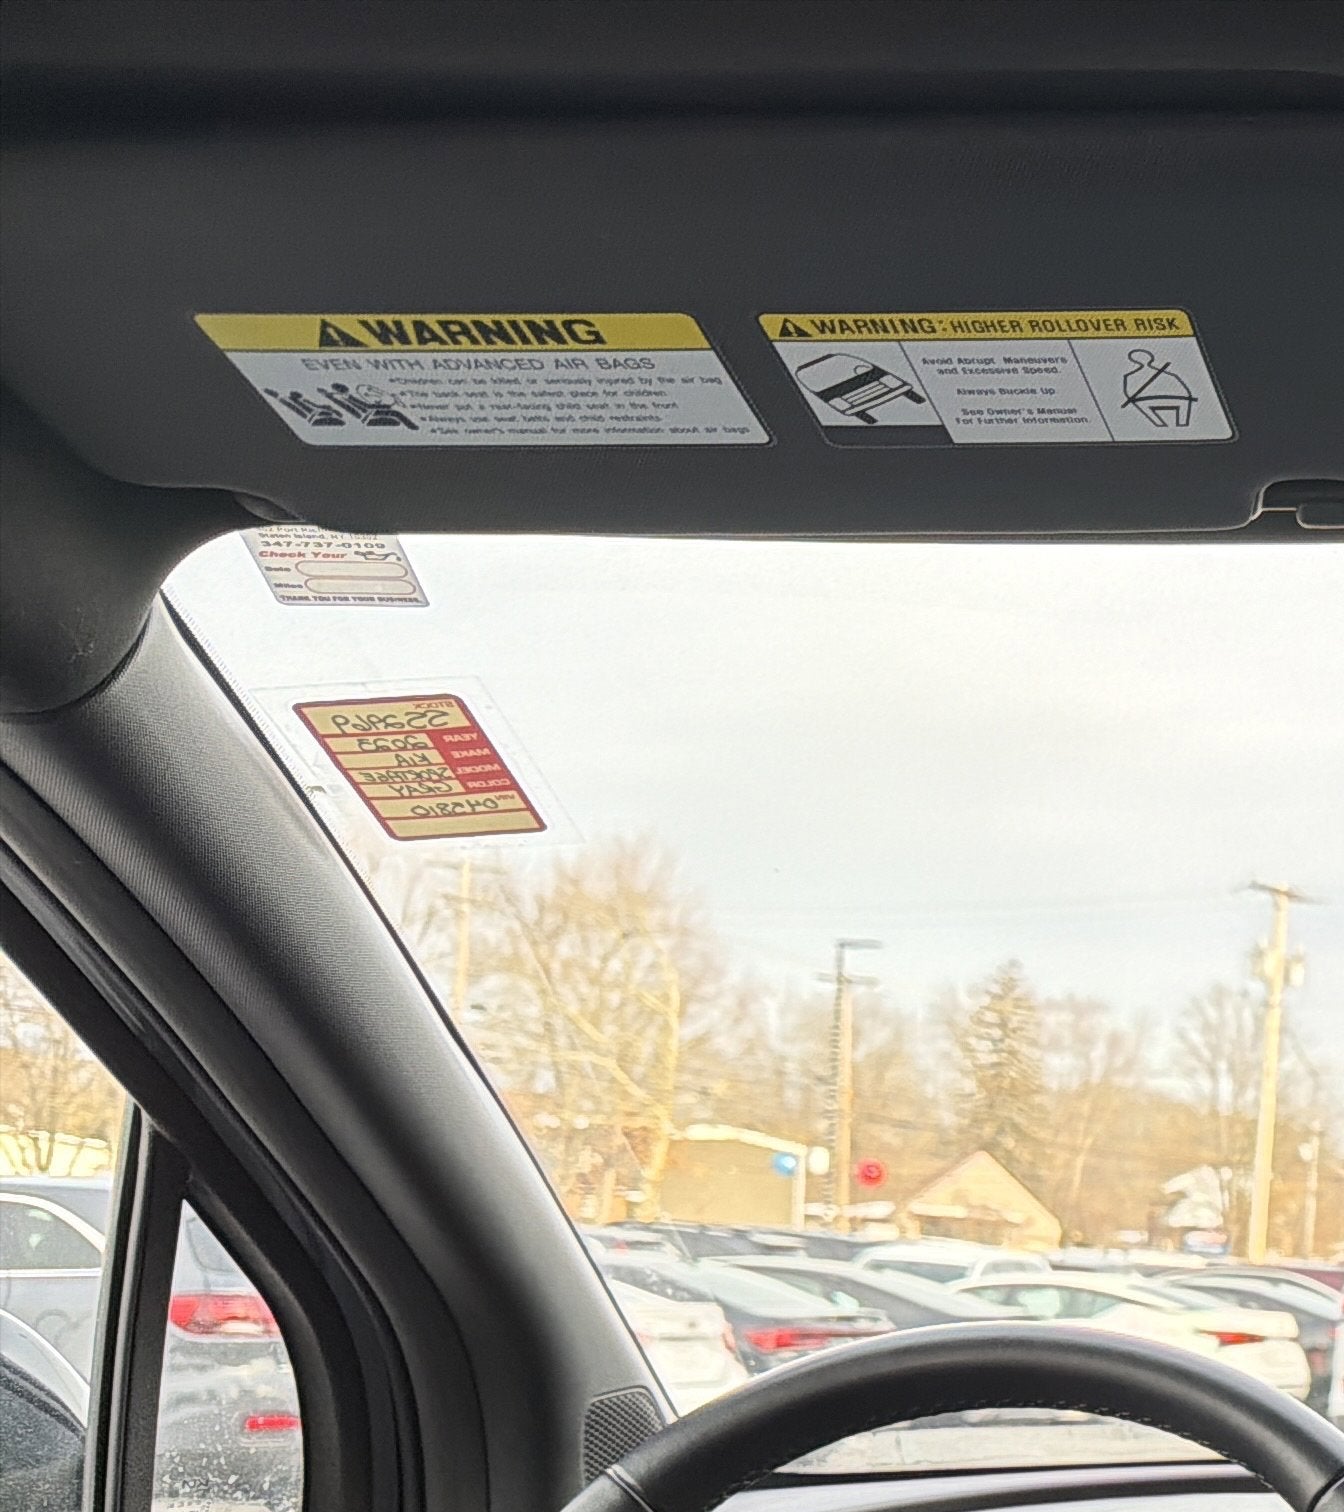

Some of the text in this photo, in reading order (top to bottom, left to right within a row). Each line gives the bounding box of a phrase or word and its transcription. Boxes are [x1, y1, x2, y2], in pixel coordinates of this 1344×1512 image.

[951, 319, 1023, 335] HIGHER
[1031, 318, 1128, 334] ROLLOVER
[1135, 316, 1181, 332] RISK
[358, 318, 607, 346] WARNING
[302, 357, 656, 371] EVEN WITH ADVANCED AIR BAGS
[922, 357, 953, 365] Avoid
[1003, 356, 1068, 364] Maneuvers
[999, 387, 1037, 395] Buckle
[1040, 388, 1056, 396] Up
[258, 550, 347, 559] Check Your
